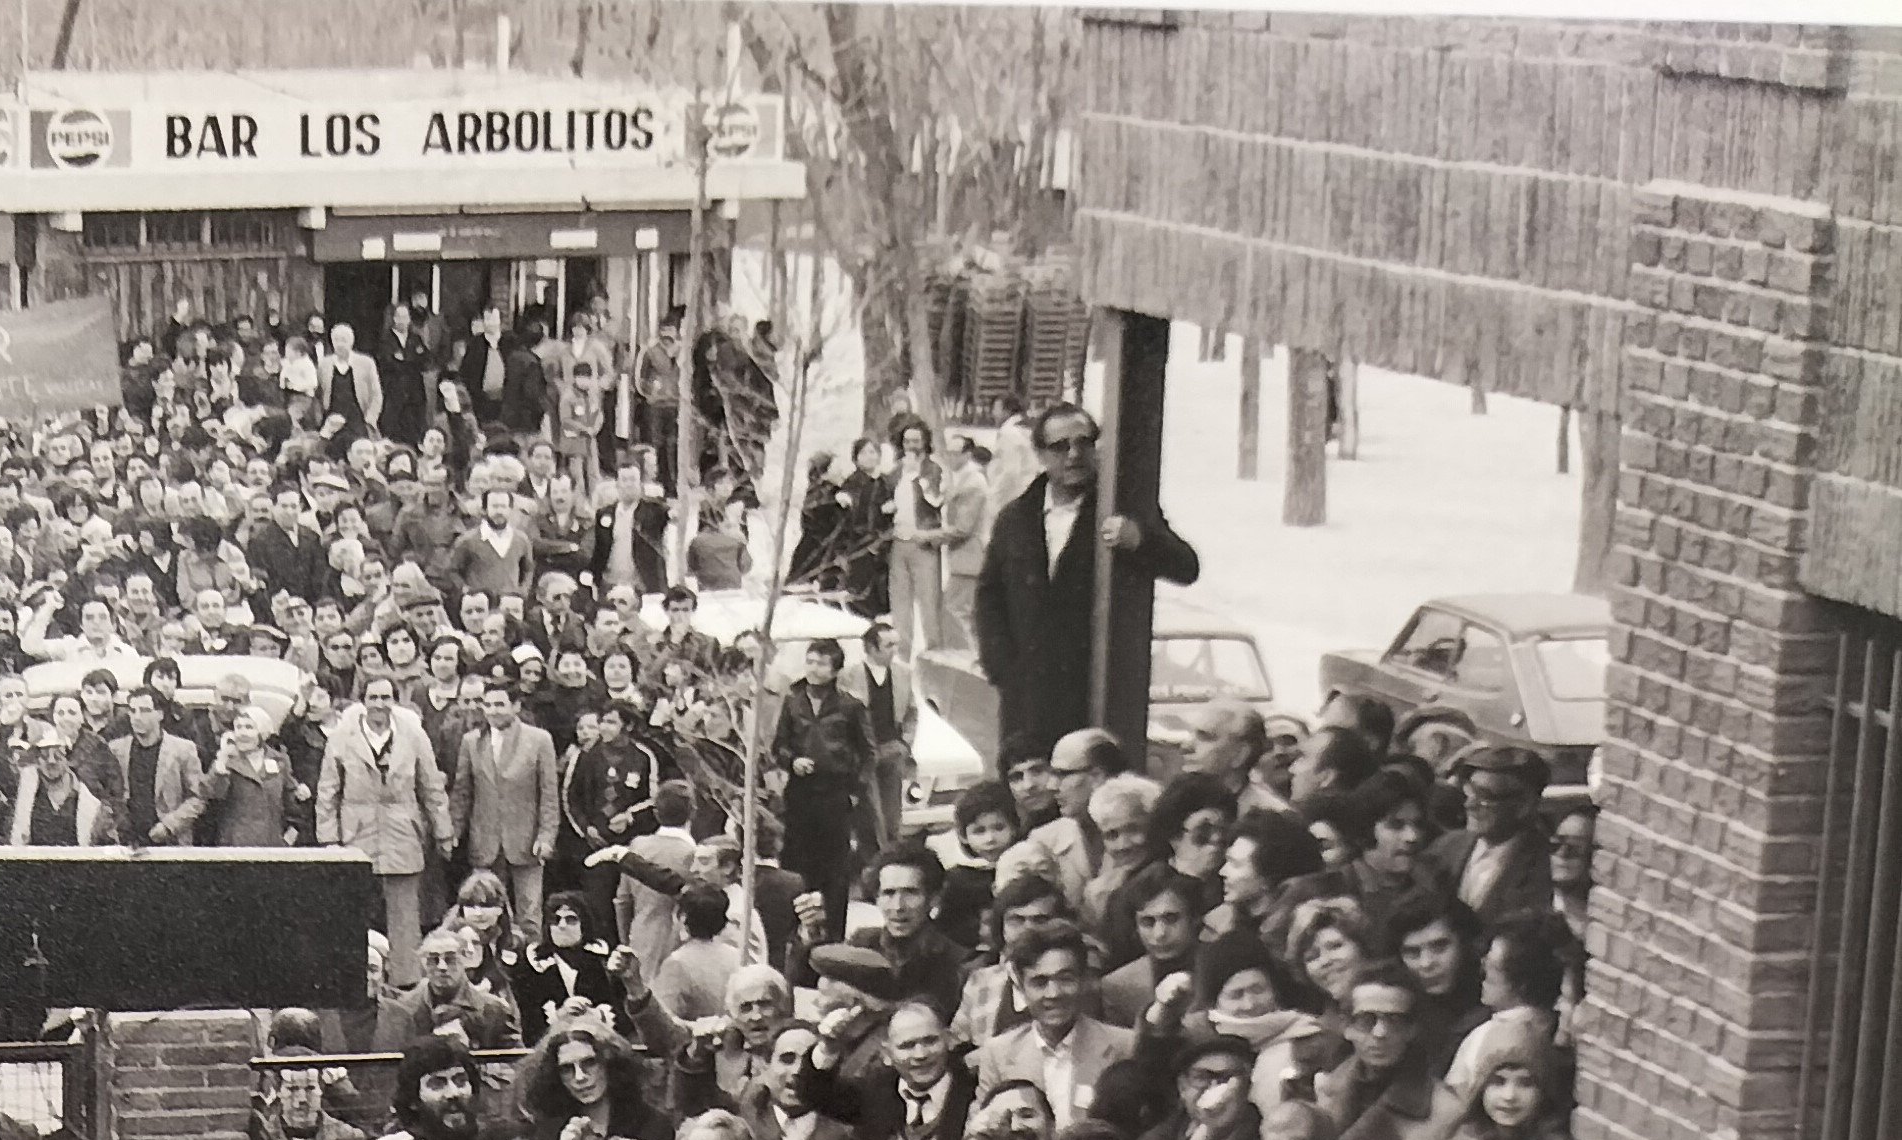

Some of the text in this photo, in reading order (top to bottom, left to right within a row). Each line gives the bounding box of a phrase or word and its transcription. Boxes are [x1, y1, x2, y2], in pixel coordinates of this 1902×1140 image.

[51, 131, 110, 147] PEPSI
[166, 107, 654, 159] BAR LOS ARBOLITOS
